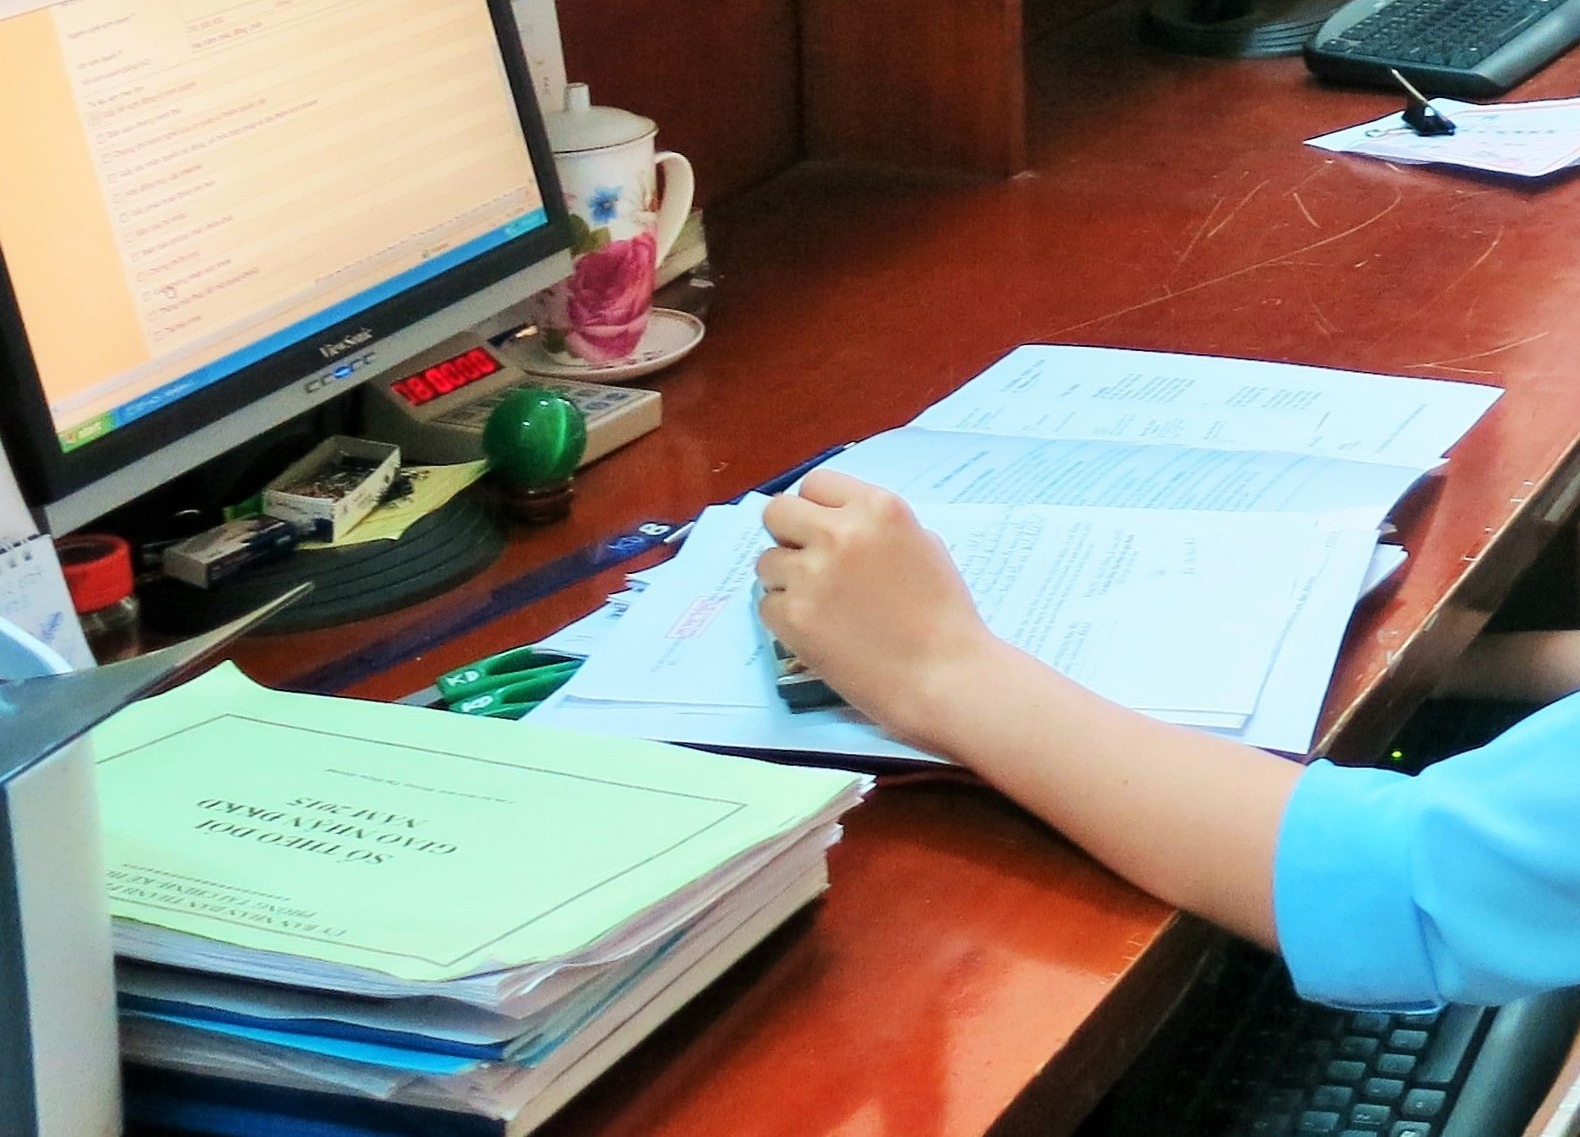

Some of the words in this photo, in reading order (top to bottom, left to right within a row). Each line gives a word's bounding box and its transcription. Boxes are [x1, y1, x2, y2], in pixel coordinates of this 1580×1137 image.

[285, 796, 352, 815] 2015
[256, 831, 343, 857] THEO
[375, 832, 459, 856] GIAO
